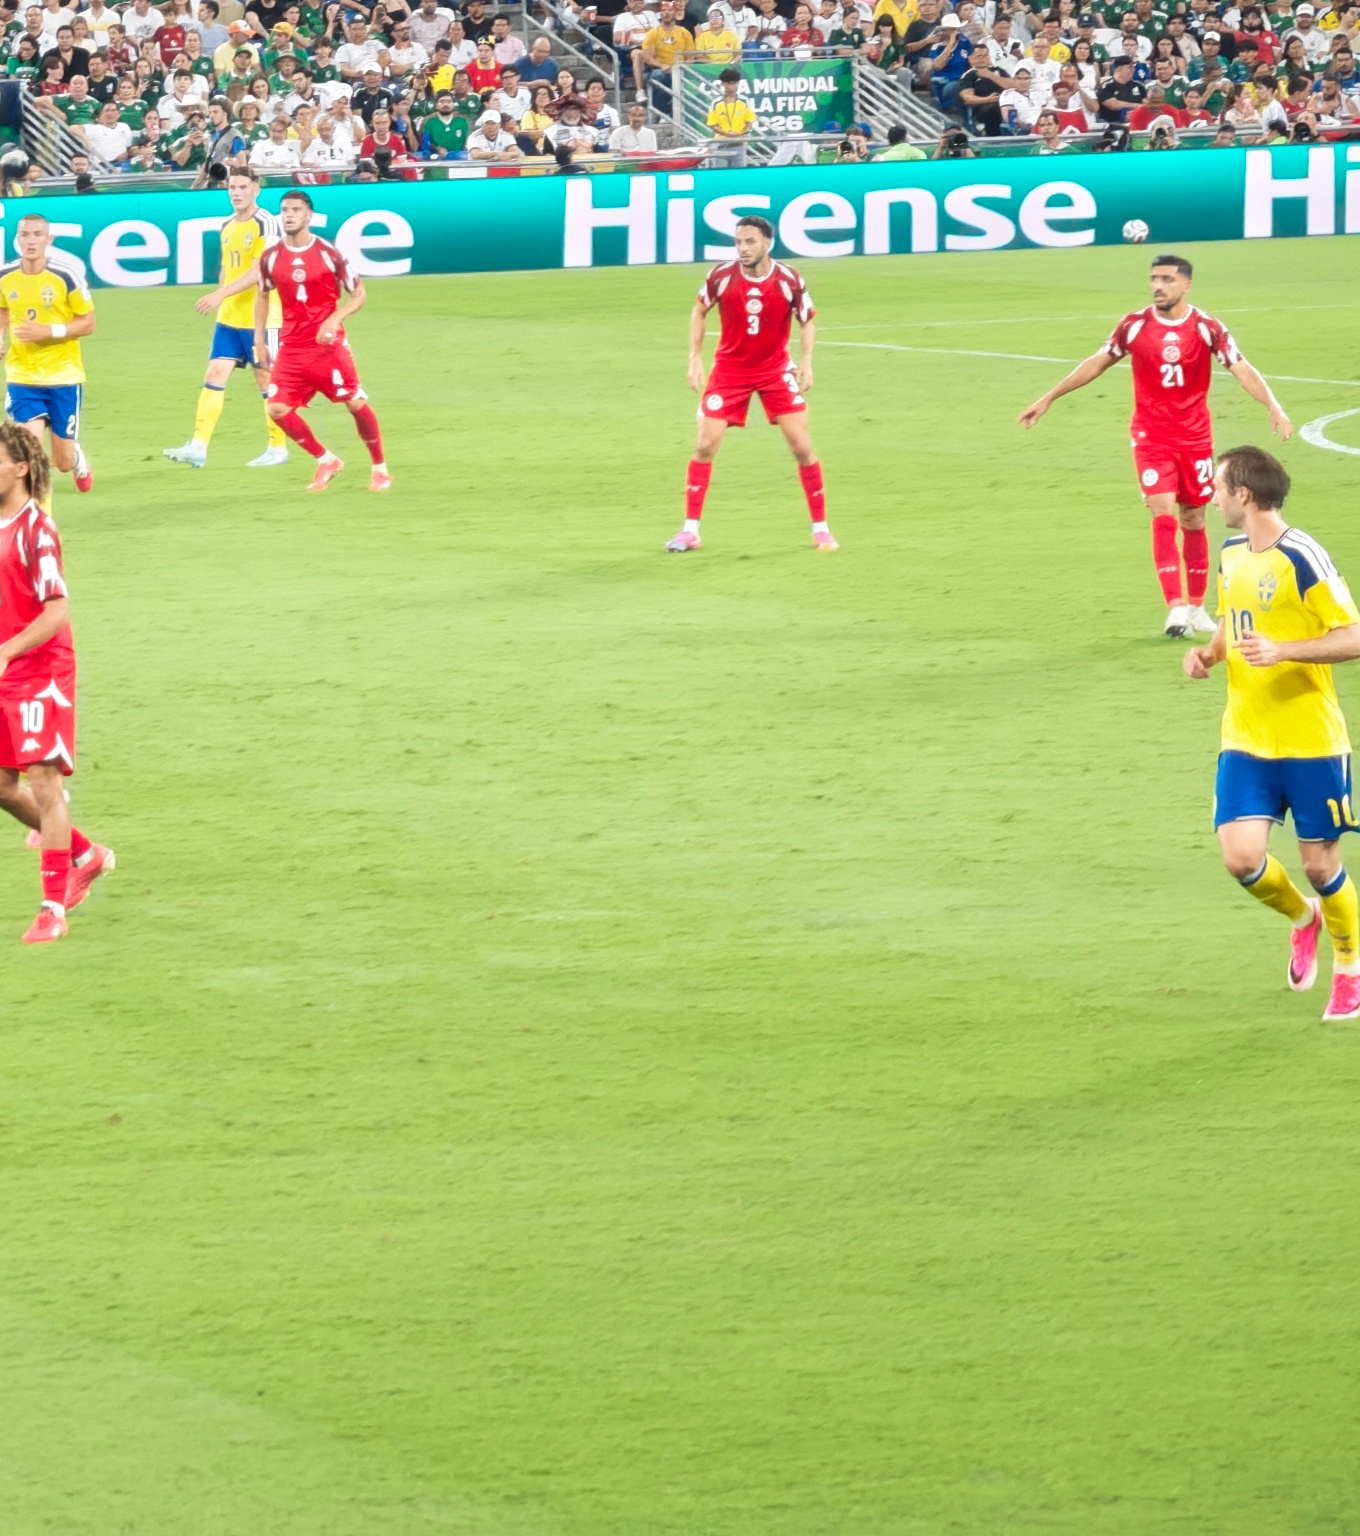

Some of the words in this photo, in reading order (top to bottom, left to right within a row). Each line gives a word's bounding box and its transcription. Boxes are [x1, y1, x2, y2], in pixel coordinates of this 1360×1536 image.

[699, 78, 751, 96] COA
[754, 75, 839, 94] MUNDIAL
[751, 97, 774, 113] LA
[776, 96, 818, 112] FIFA
[750, 115, 804, 132] 026
[1243, 146, 1360, 240] Hi
[562, 174, 1098, 269] Hisense
[296, 284, 308, 304] 4
[747, 314, 760, 335] 3
[332, 368, 344, 386] 4
[783, 372, 799, 393] 3
[1159, 362, 1185, 389] 21
[66, 414, 76, 436] 2
[1194, 456, 1213, 484] 21
[19, 699, 46, 734] 10
